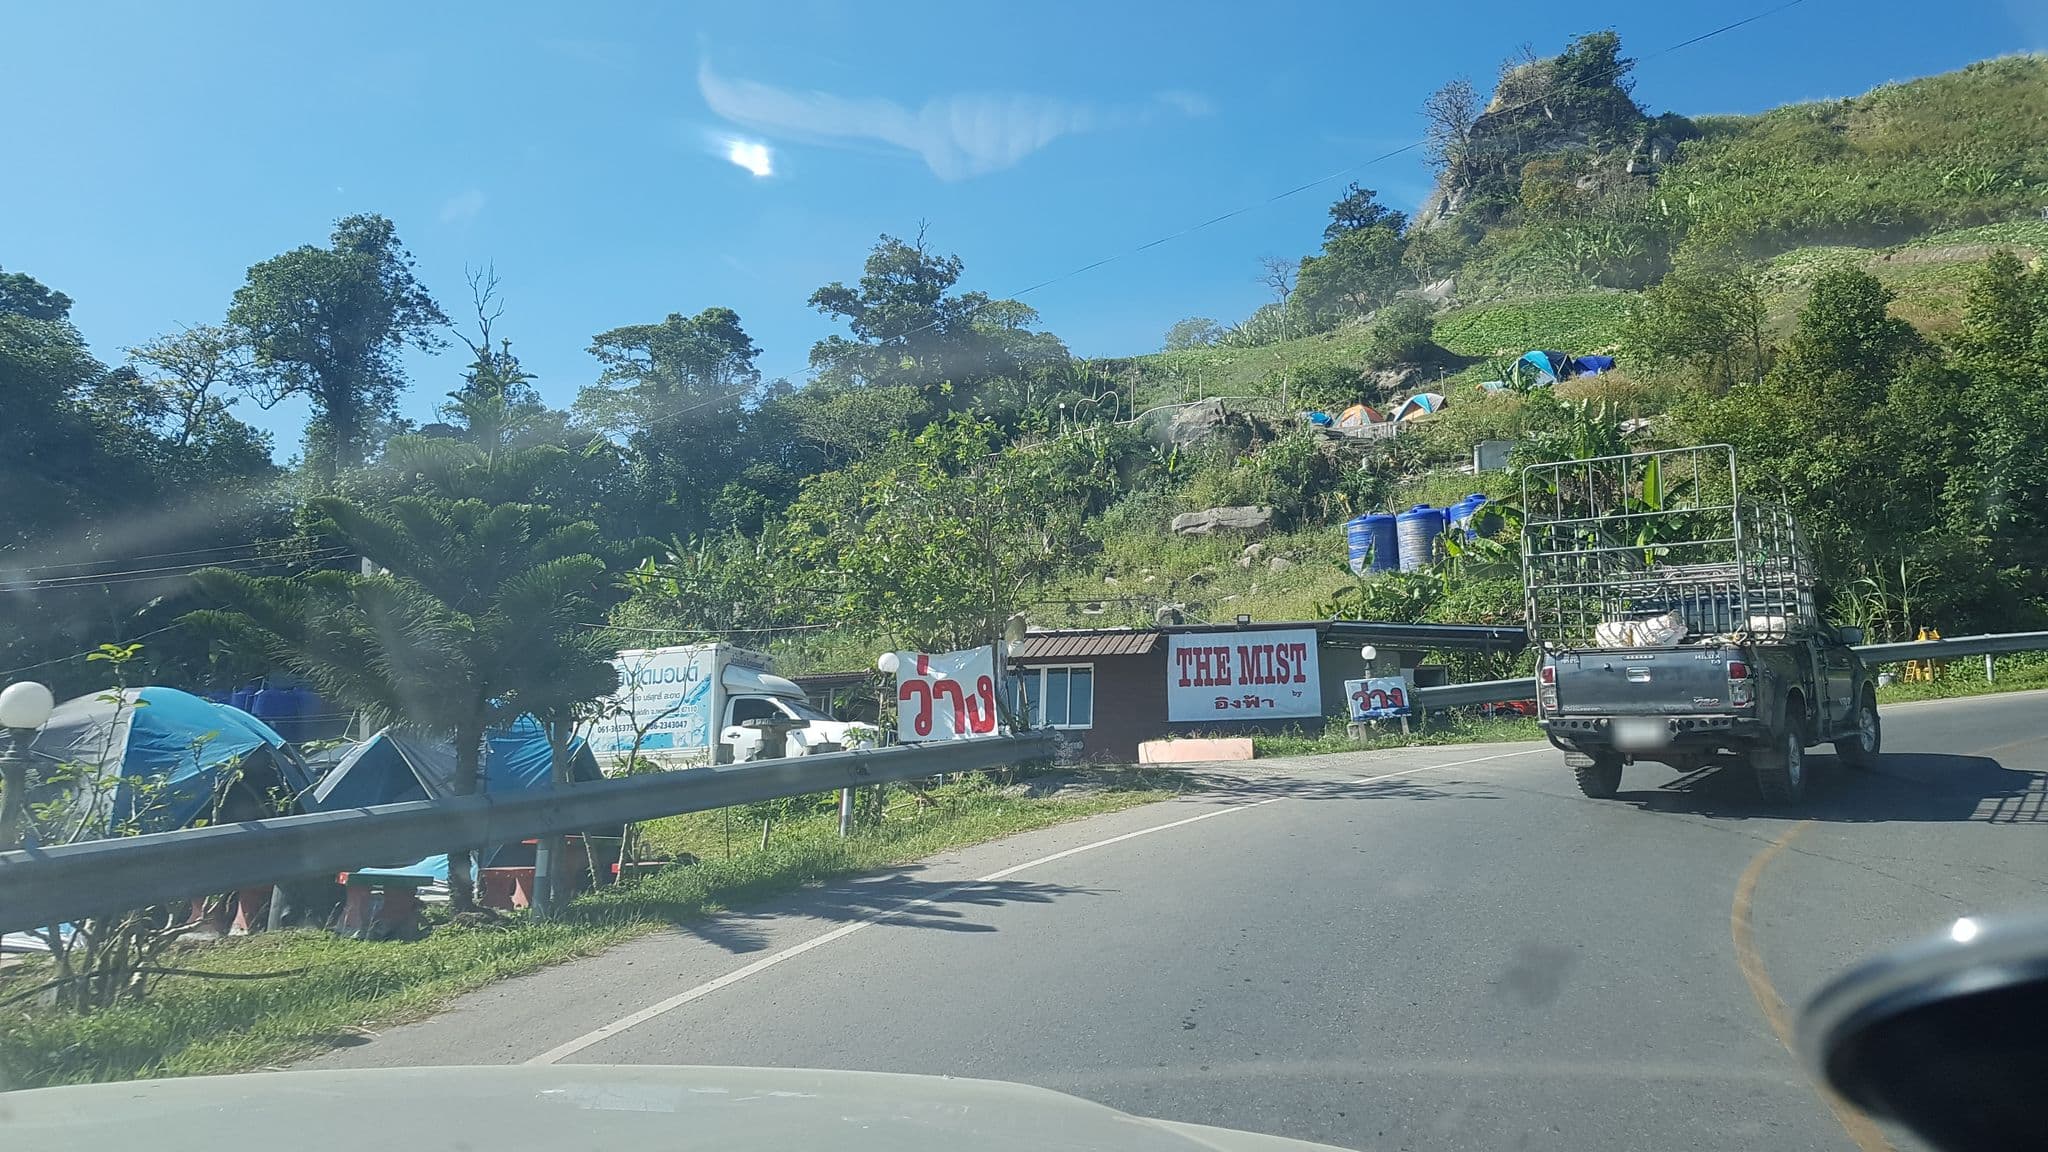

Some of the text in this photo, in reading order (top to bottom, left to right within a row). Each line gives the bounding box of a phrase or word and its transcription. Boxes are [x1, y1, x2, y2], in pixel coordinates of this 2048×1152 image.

[1176, 643, 1307, 687] THE MIST
[899, 654, 996, 737] ว่าง
[1214, 695, 1275, 710] อิงฟ้า
[1291, 689, 1303, 698] by
[1351, 682, 1405, 711] ว่าง
